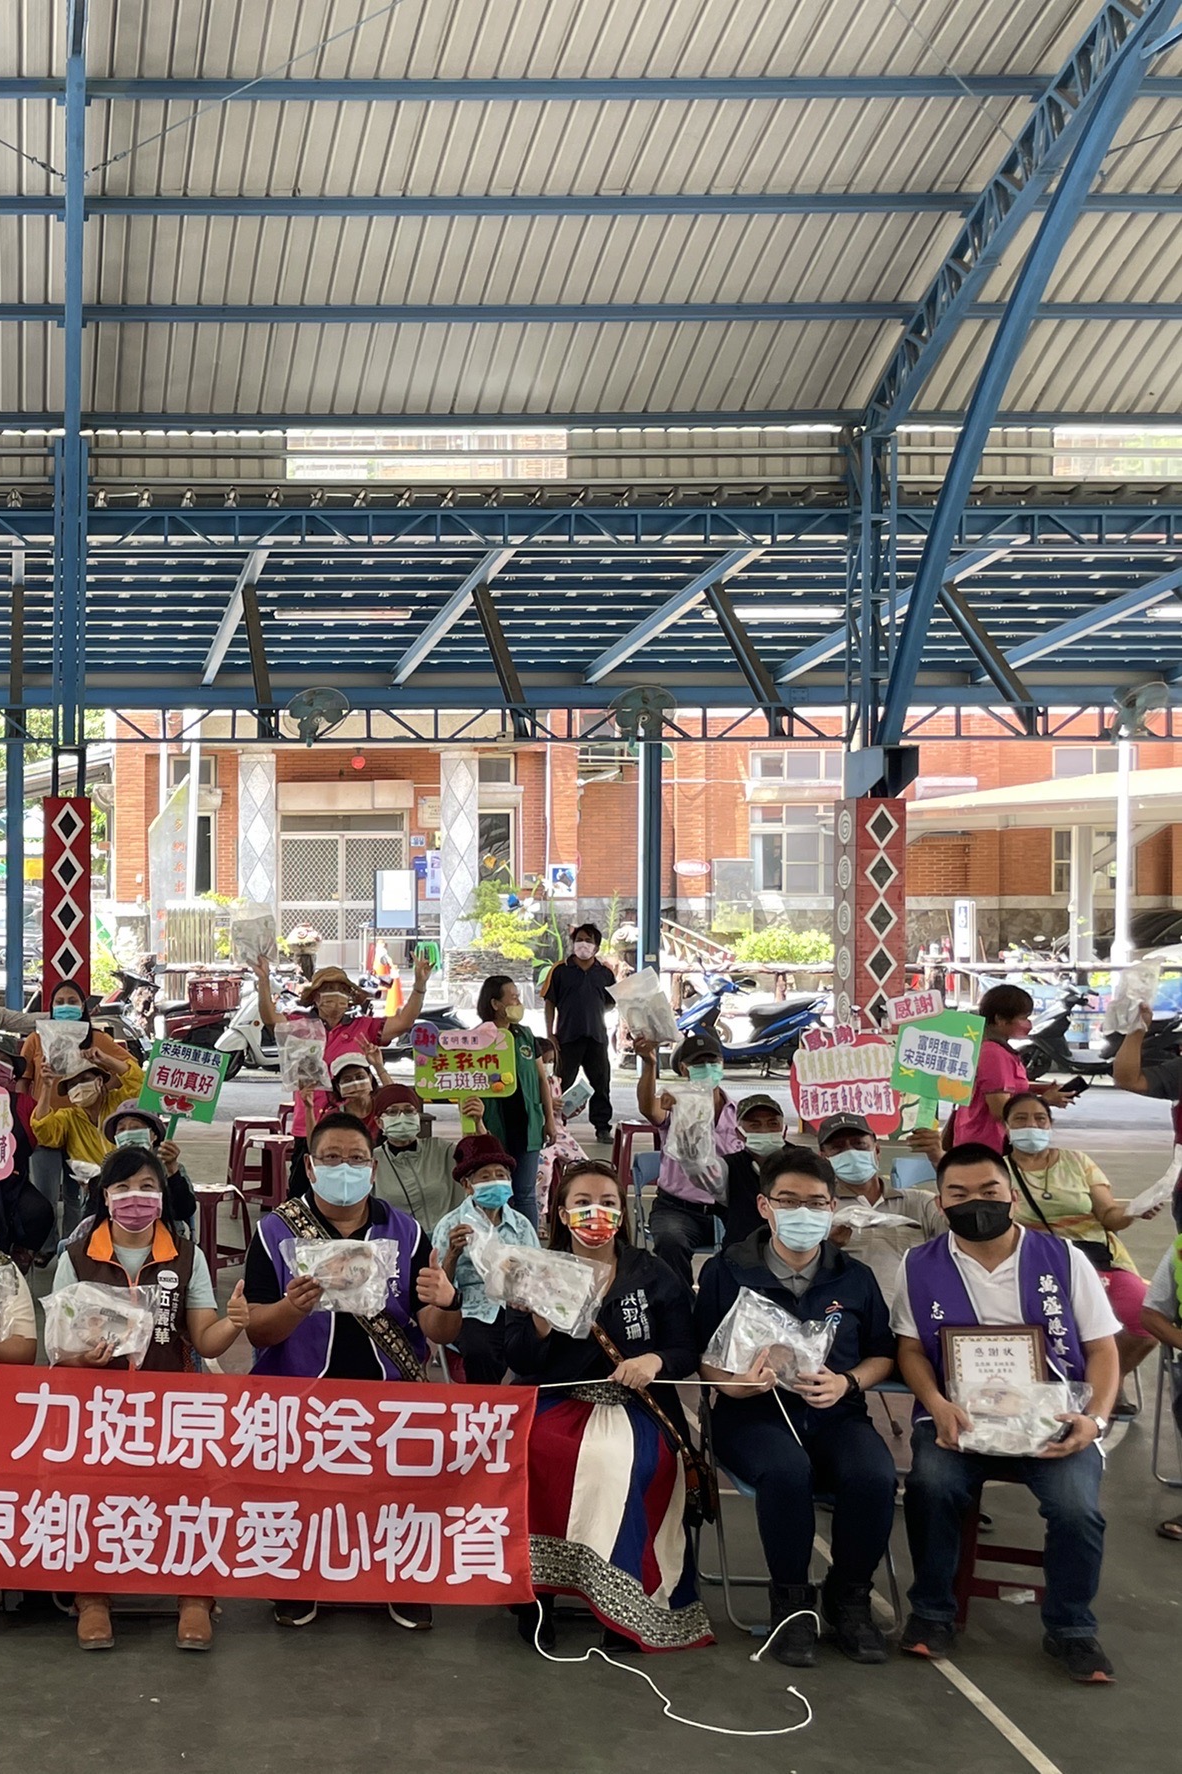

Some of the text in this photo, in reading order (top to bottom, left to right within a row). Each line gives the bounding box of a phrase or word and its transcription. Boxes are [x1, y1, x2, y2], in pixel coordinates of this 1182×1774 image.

[894, 993, 934, 1020] 感謝
[441, 1036, 479, 1045] 富明集團
[919, 1034, 962, 1058] 富明集團
[161, 1043, 222, 1067] 宋英明董事長
[902, 1048, 969, 1079] 宋英明董事長
[156, 1065, 215, 1095] 有你真好
[437, 1072, 489, 1090] 石斑魚
[11, 1383, 518, 1476] 力挺原鄉送石斑
